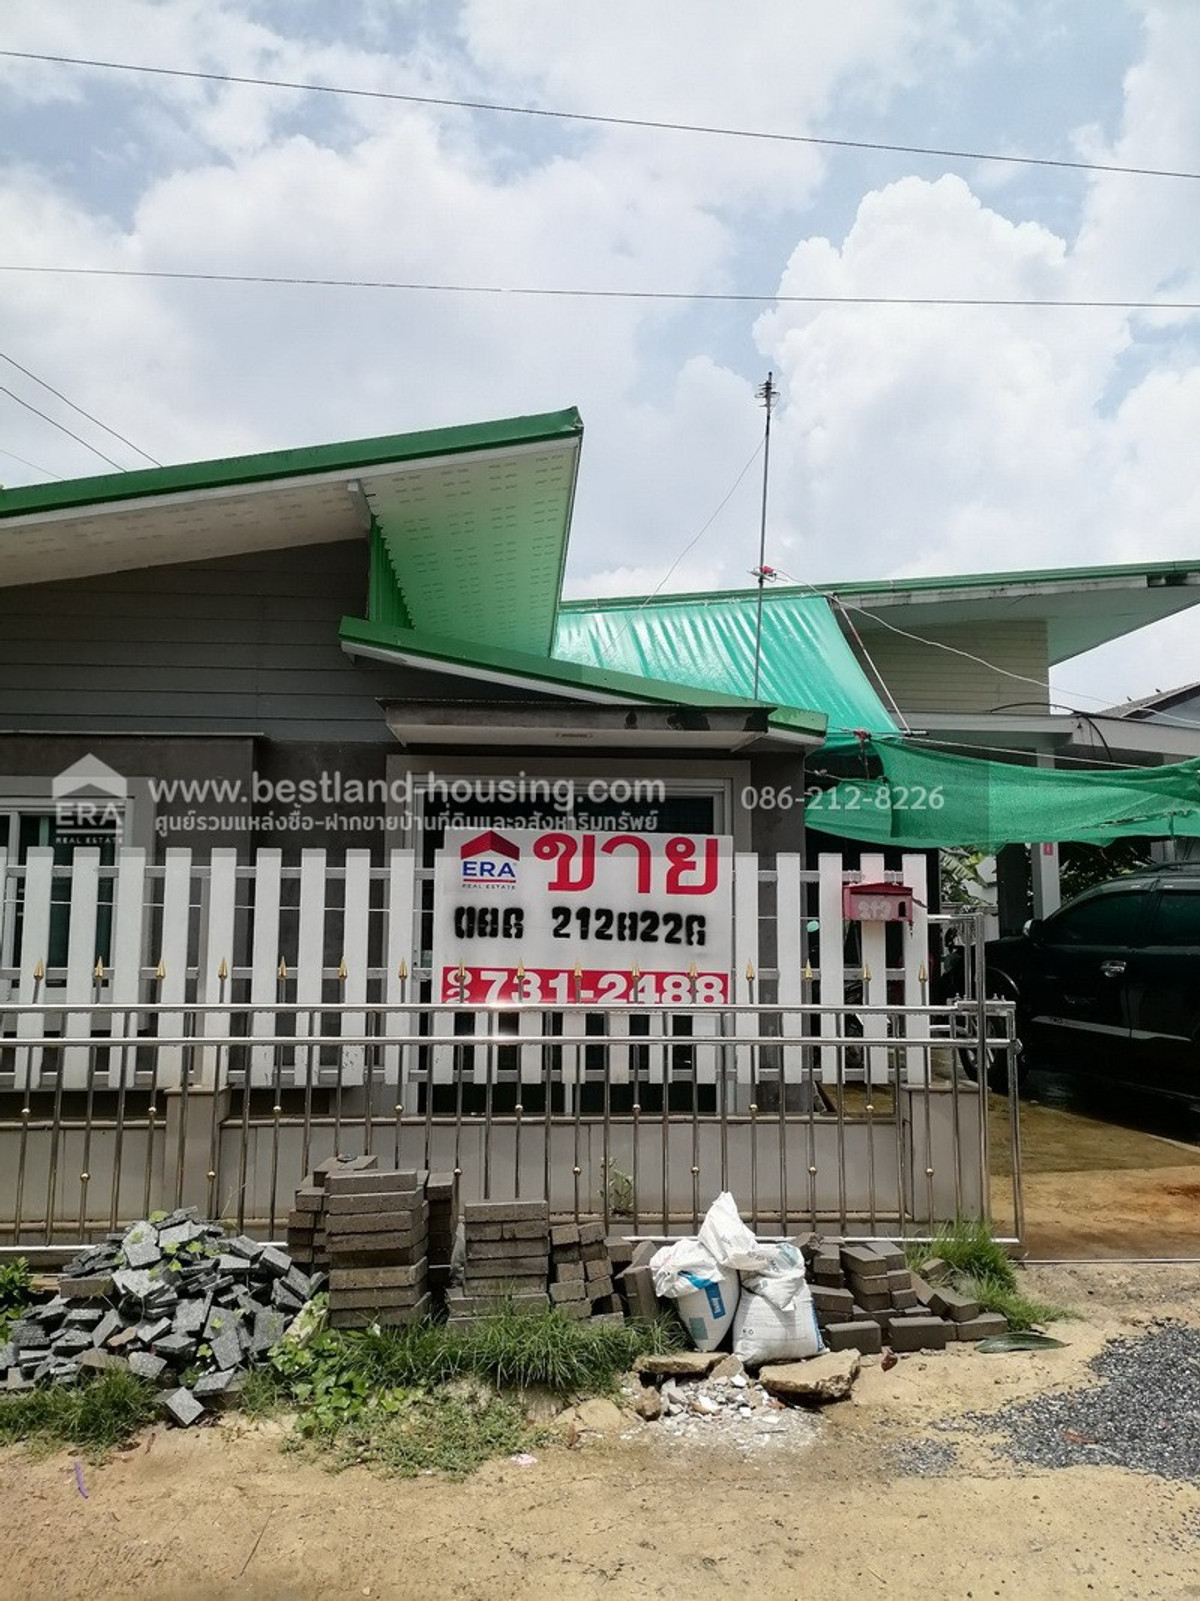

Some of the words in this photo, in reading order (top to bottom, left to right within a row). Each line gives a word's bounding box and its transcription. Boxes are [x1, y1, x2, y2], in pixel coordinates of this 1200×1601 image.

[462, 860, 516, 877] ERA
[532, 832, 719, 896] ขาย
[455, 906, 524, 939] 086
[551, 906, 706, 946] 2128226
[480, 970, 725, 1004] 731-2488
